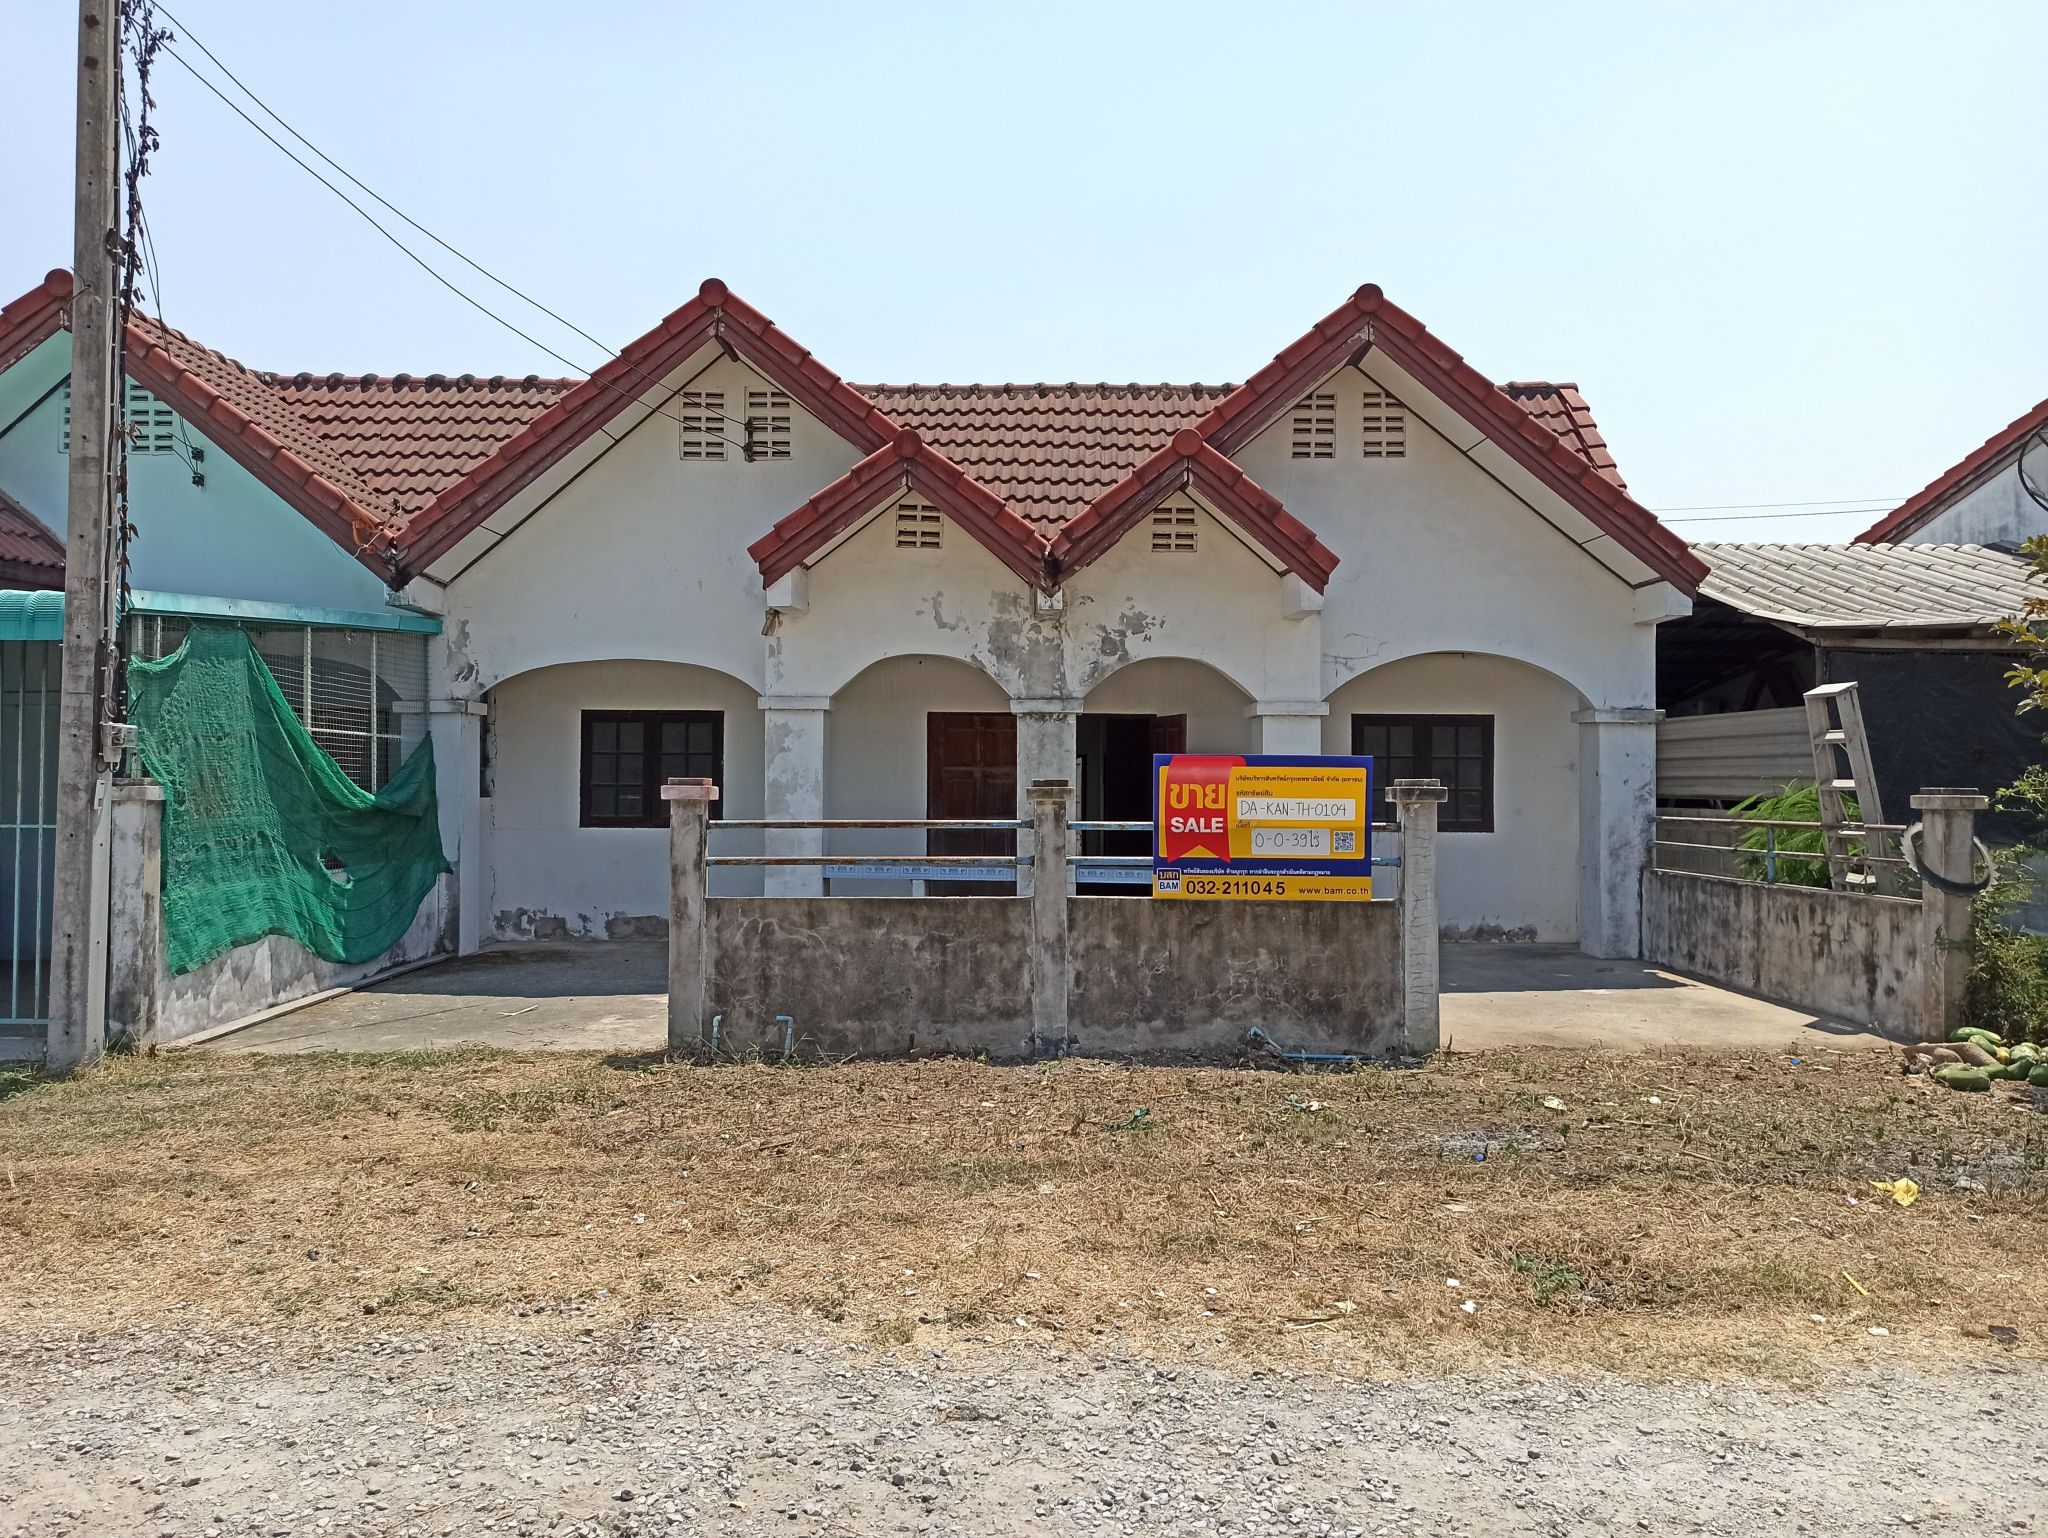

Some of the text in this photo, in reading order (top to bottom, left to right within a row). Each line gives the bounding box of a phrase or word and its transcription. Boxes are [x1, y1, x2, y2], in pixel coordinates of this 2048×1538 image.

[1170, 783, 1225, 809] ขาย
[1240, 800, 1347, 817] DA-KAN-TH-0104
[1170, 817, 1224, 833] SALE
[1159, 881, 1179, 890] BAM
[1186, 880, 1286, 895] 032-211045
[1298, 886, 1369, 895] www.bam.co.th
